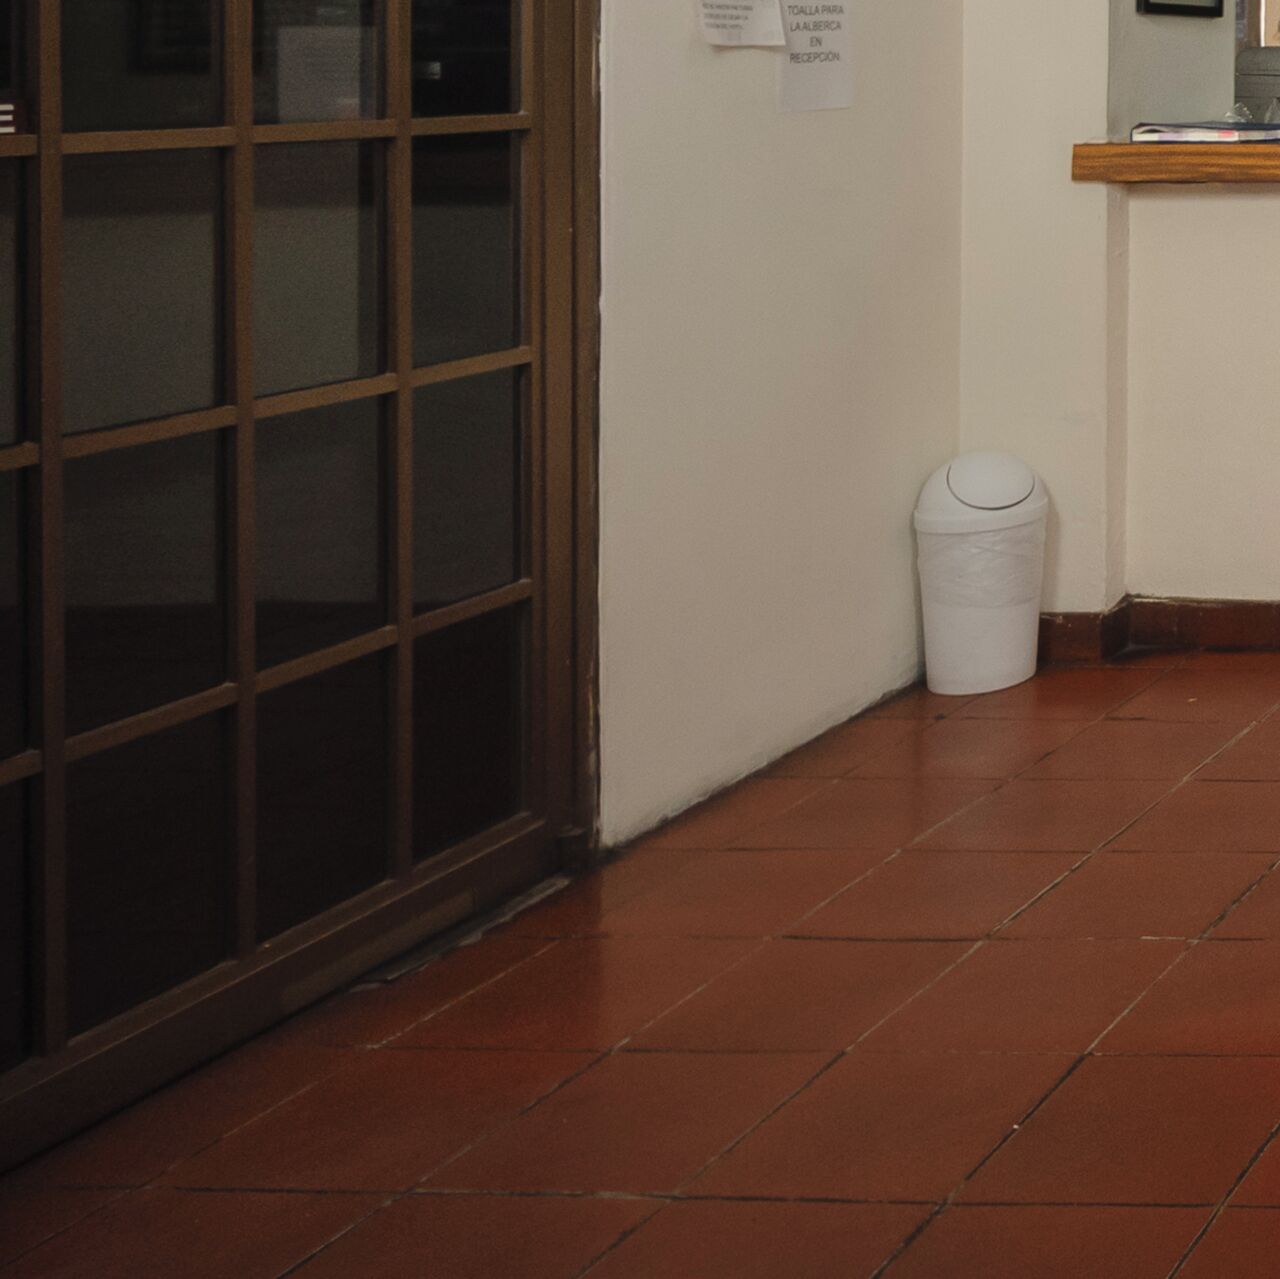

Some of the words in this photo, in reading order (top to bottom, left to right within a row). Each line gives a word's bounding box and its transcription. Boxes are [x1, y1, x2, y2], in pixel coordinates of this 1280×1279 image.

[787, 5, 819, 16] TOALLA
[821, 4, 844, 15] PARA
[810, 36, 822, 47] EN
